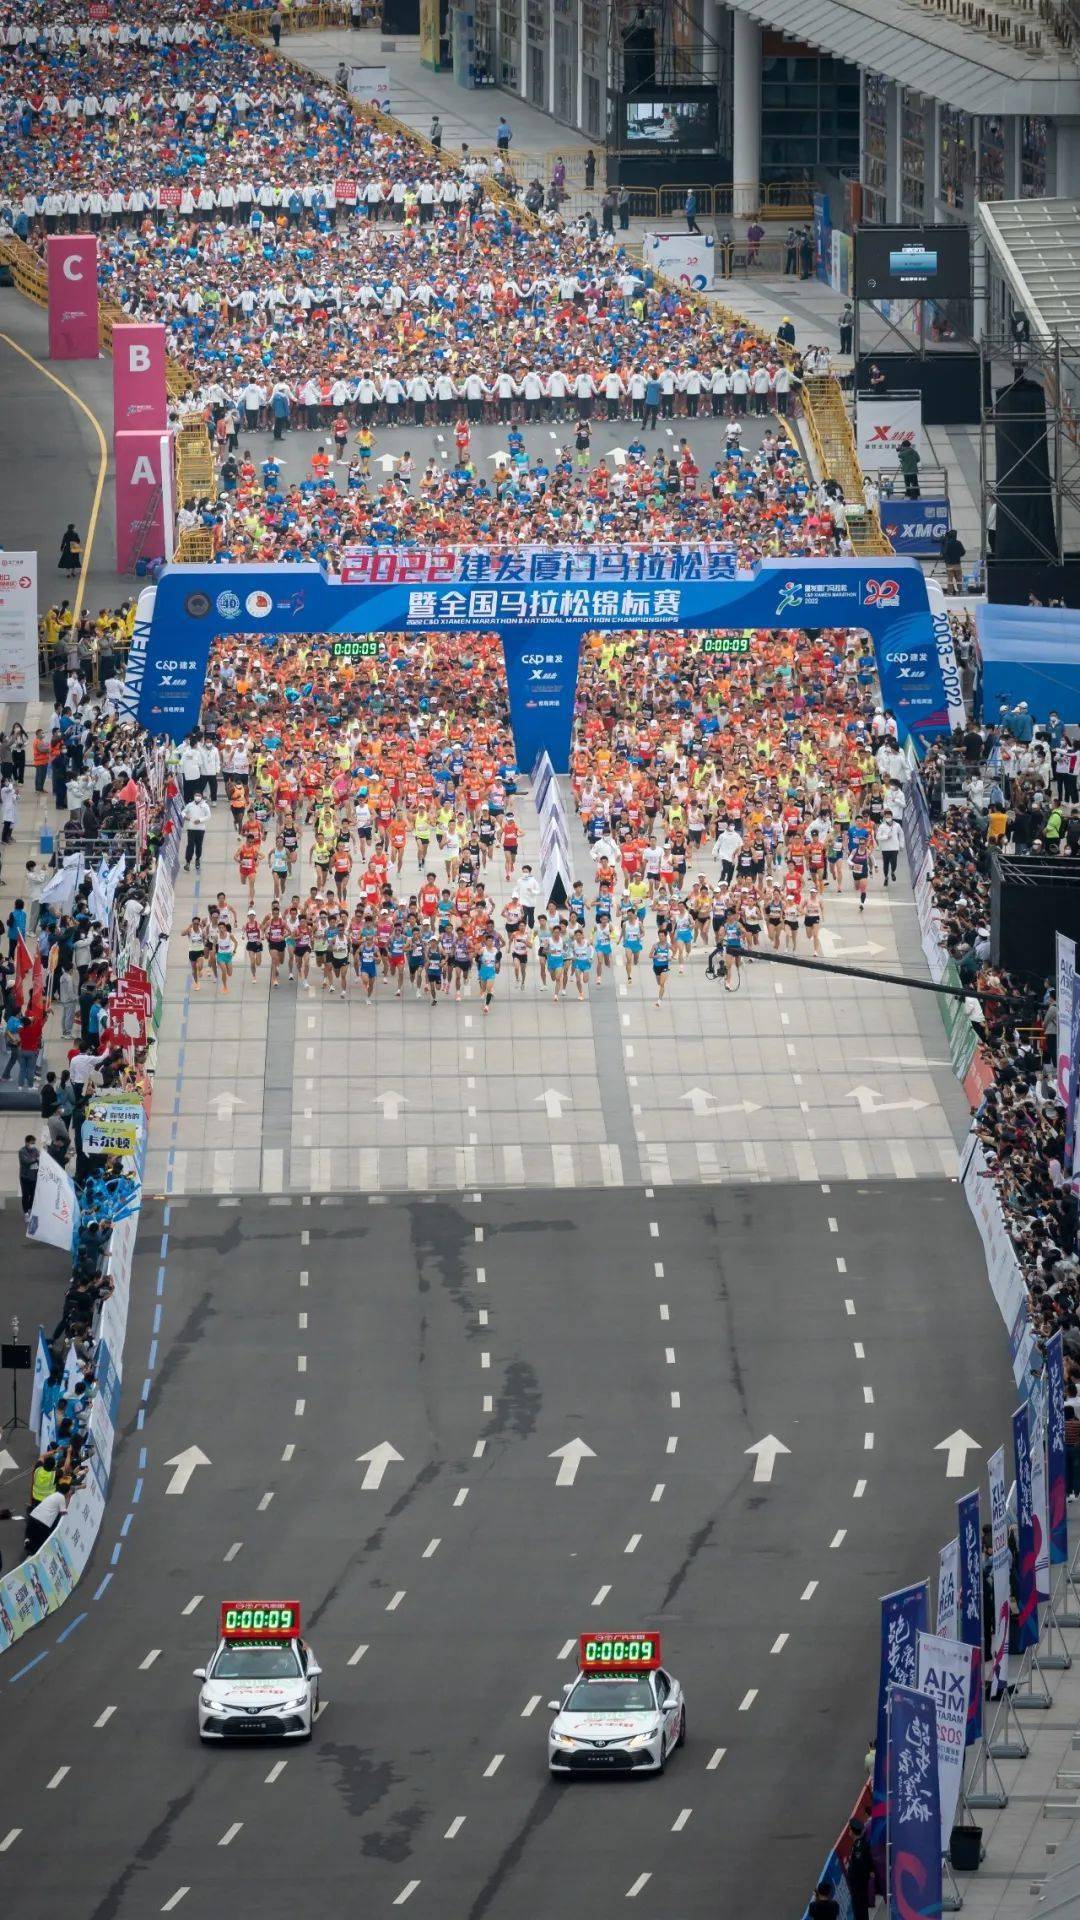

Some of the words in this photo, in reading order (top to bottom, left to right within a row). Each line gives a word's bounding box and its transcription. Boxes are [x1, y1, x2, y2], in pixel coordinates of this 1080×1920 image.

[62, 255, 84, 281] C
[129, 344, 151, 372] B
[130, 456, 156, 485] A
[900, 523, 947, 538] XMG
[407, 588, 681, 618] 暨全国马拉松锦标赛
[523, 617, 565, 625] NATIONAL
[565, 616, 611, 624] MARATHON
[611, 615, 680, 623] CHAMPIONSHIPS
[334, 643, 377, 655] 0:00:09
[704, 639, 748, 652] 0:00:09
[155, 660, 177, 671] C&D
[521, 654, 545, 665] C&D
[886, 653, 909, 663] C&D
[932, 612, 963, 707] 2003-2022
[85, 1135, 131, 1149] 卡尔顿
[226, 1610, 292, 1629] 0:00:09
[586, 1641, 653, 1661] 0:00:09
